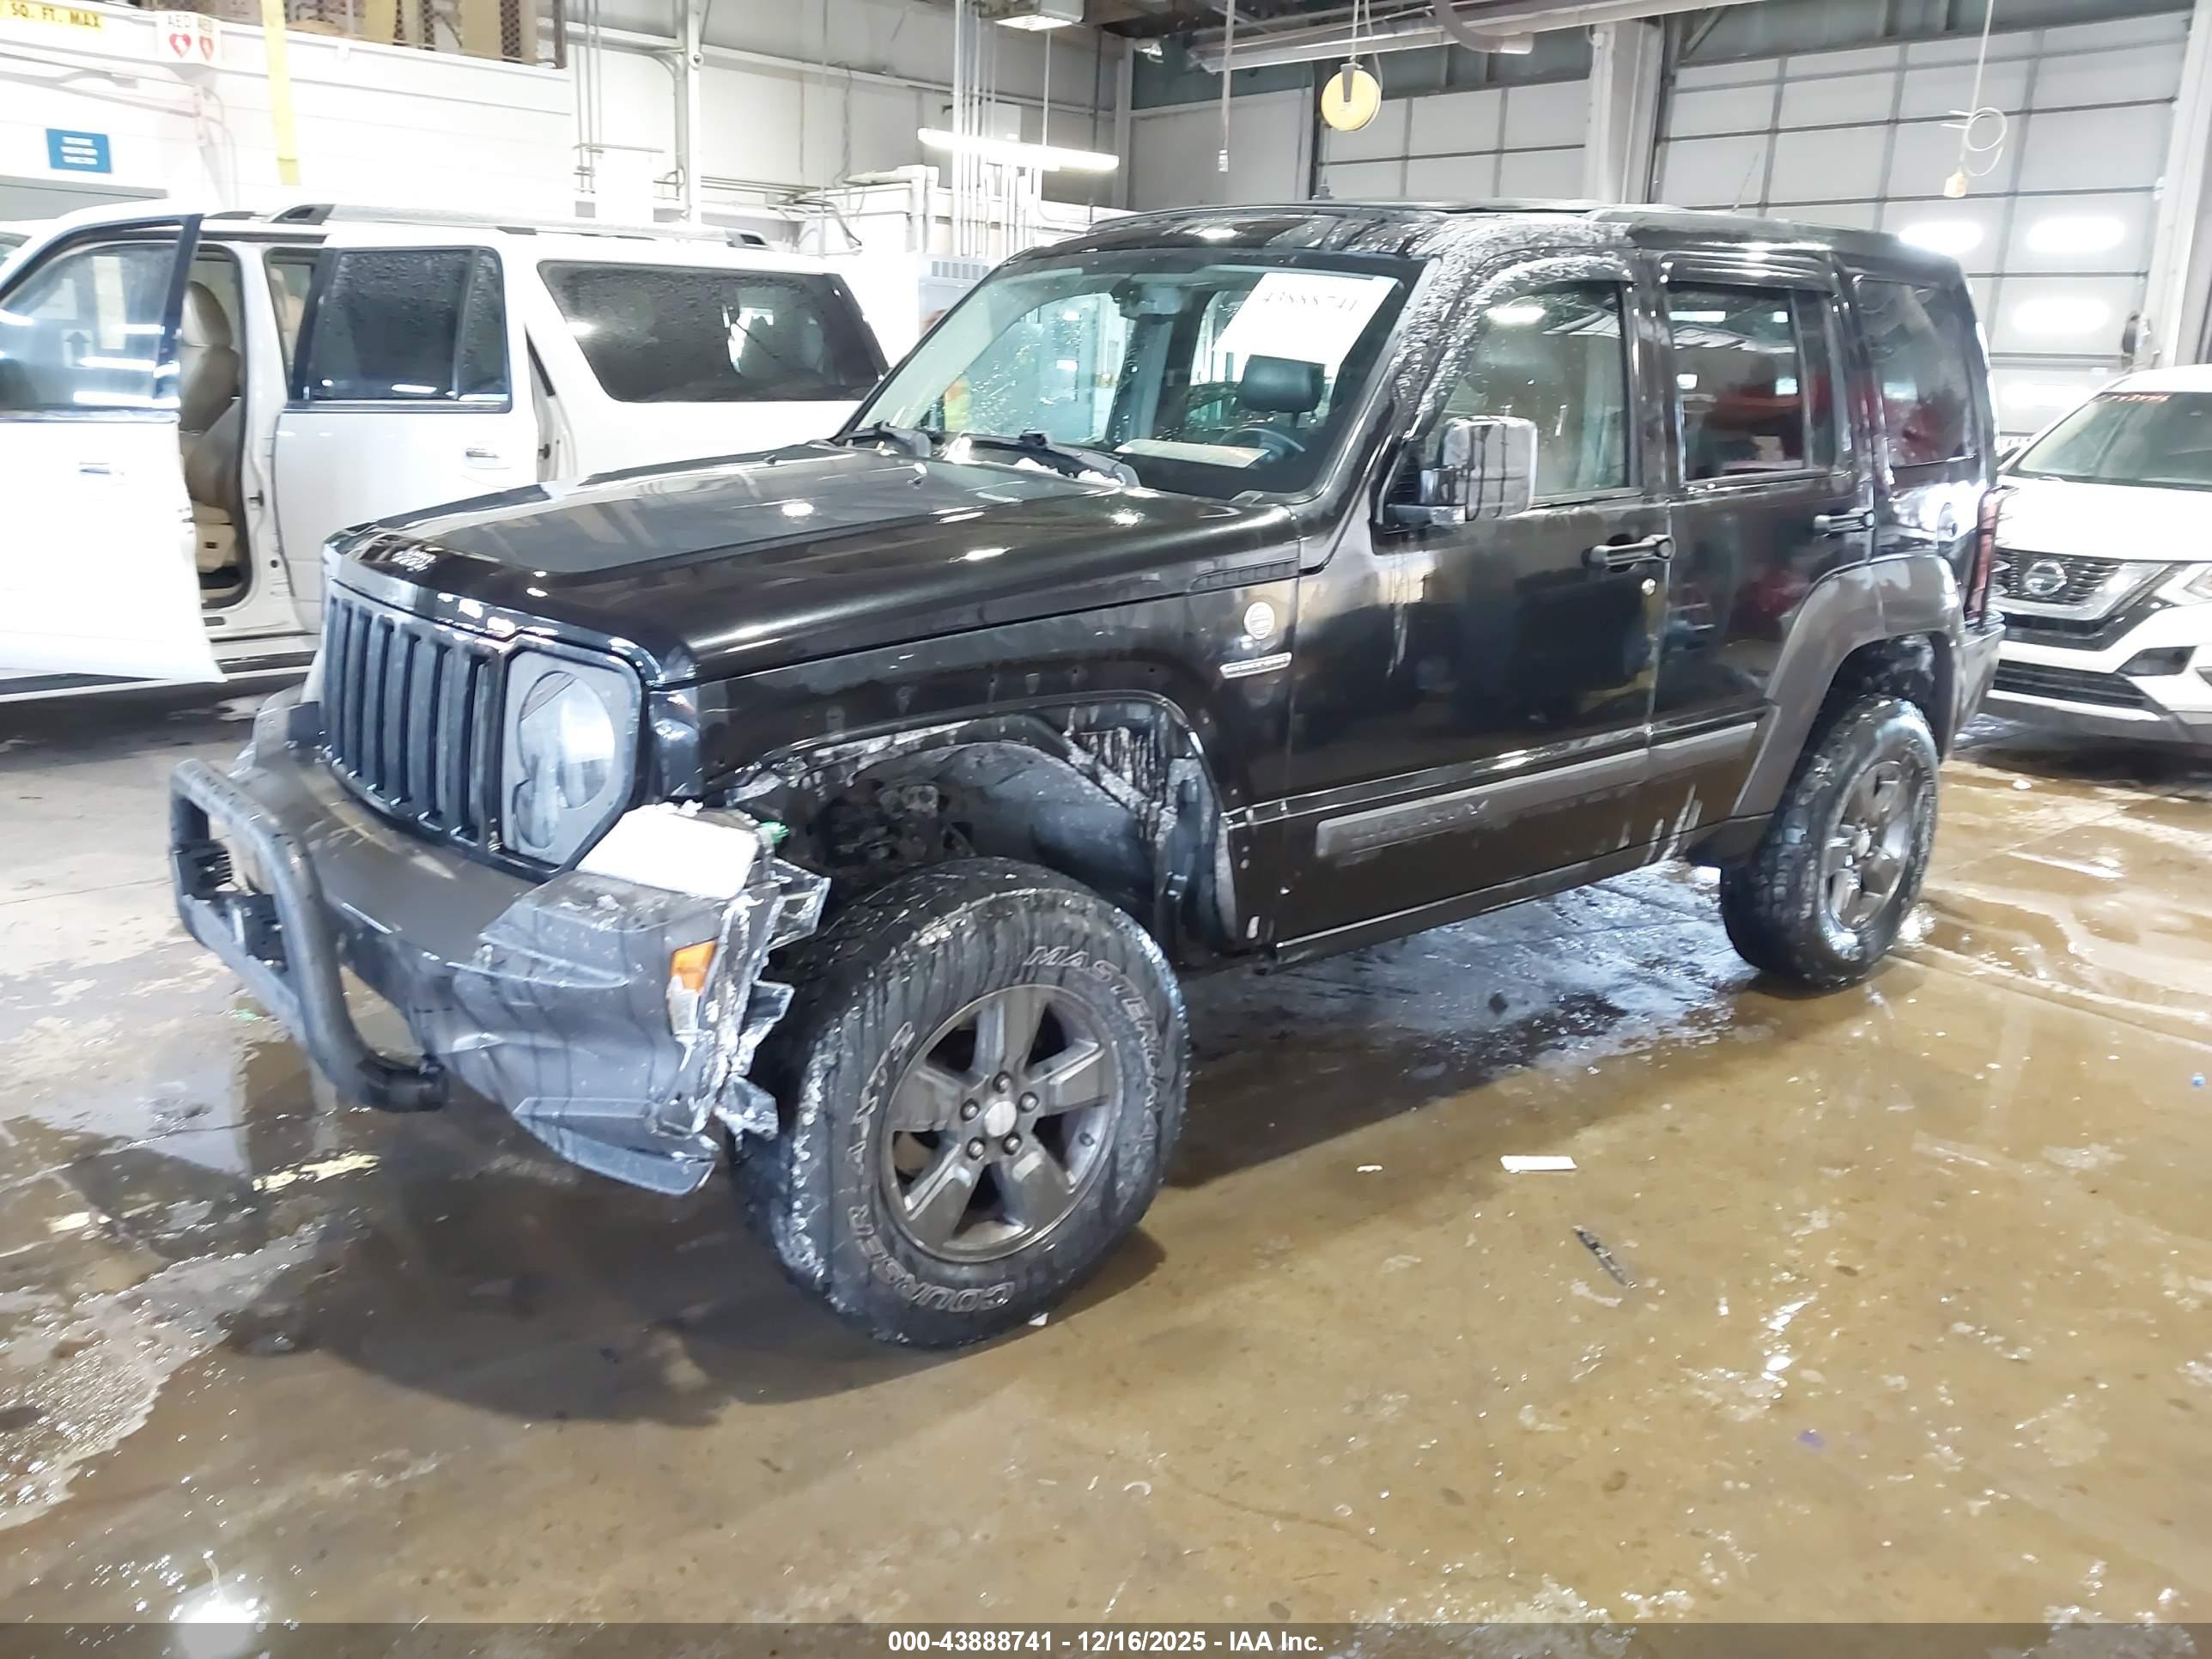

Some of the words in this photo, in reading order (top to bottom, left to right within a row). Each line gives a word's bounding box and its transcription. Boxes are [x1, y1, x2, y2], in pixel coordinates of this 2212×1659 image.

[10, 2, 34, 18] SQ.
[41, 7, 63, 21] FT.
[70, 10, 101, 28] MAX
[167, 14, 192, 28] AED
